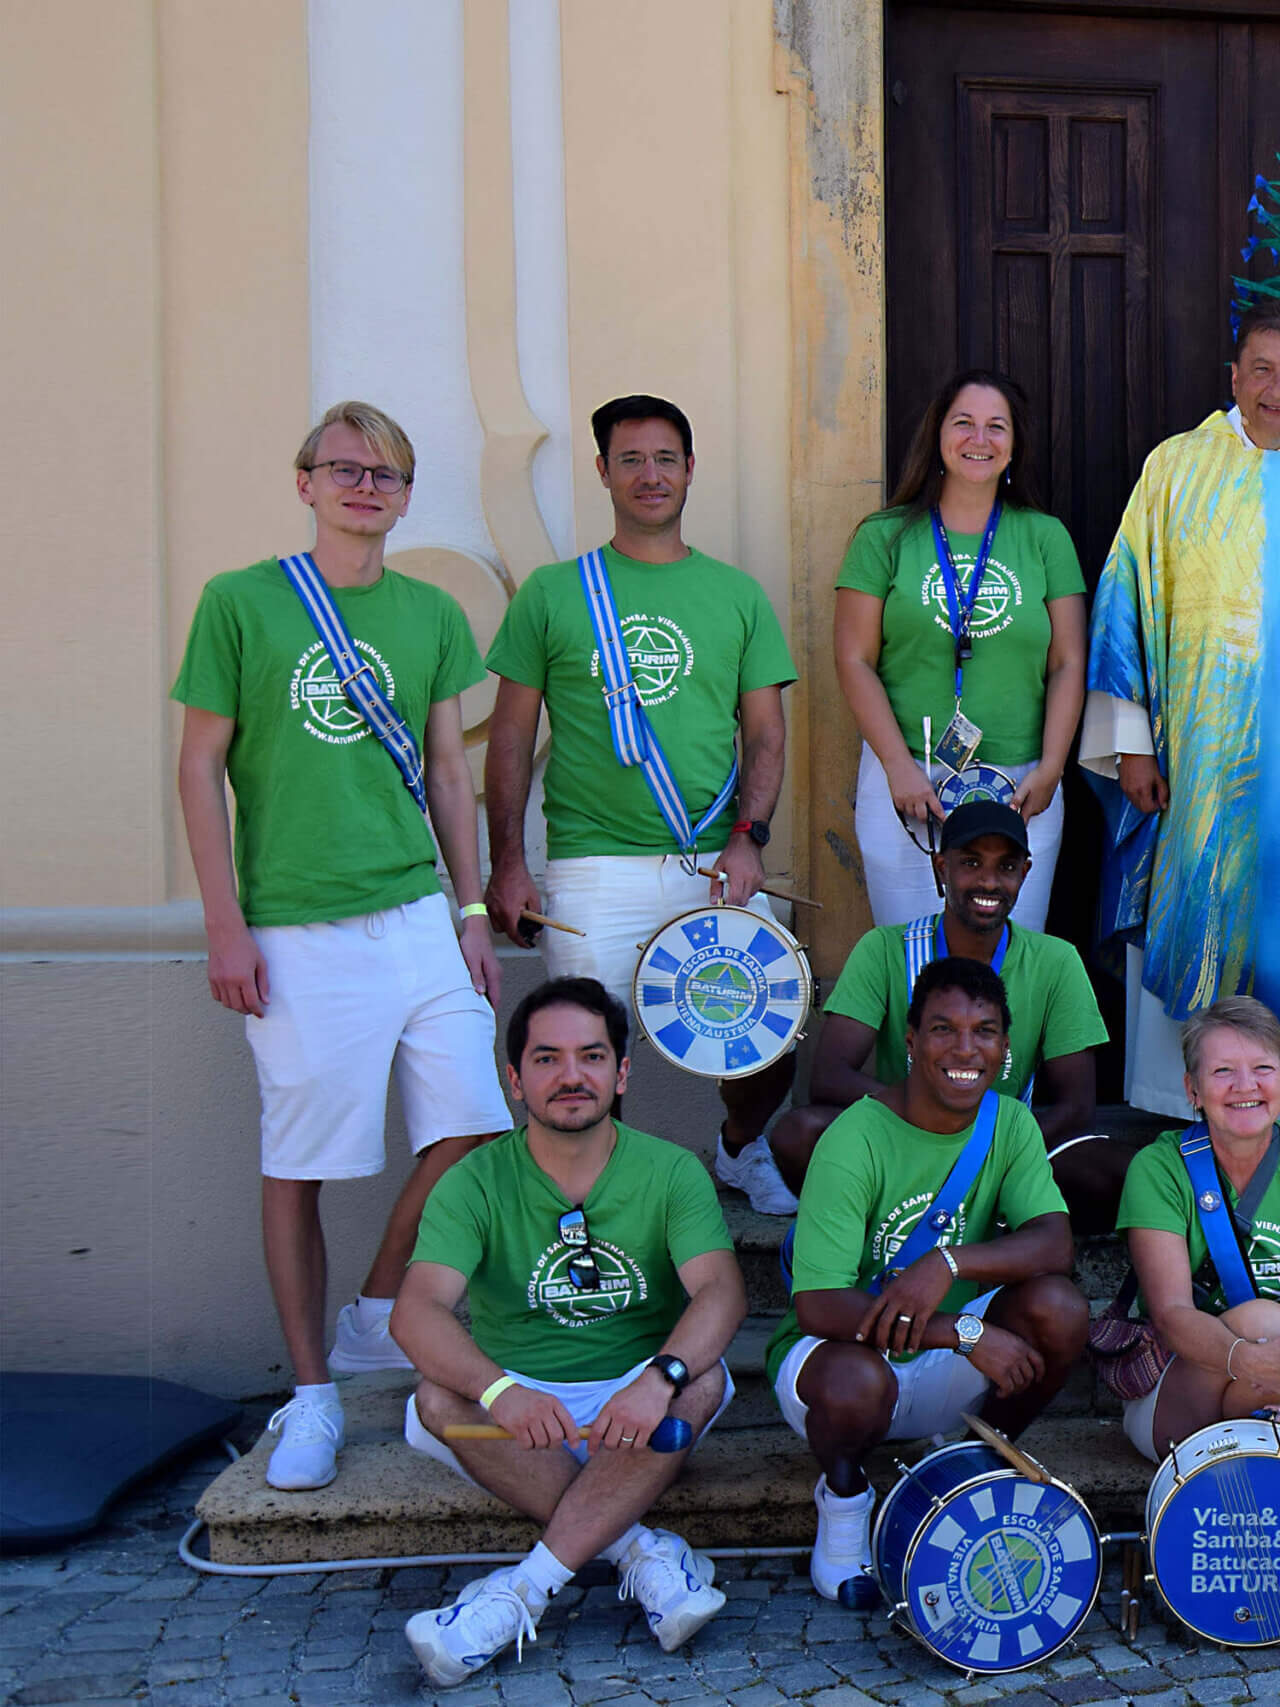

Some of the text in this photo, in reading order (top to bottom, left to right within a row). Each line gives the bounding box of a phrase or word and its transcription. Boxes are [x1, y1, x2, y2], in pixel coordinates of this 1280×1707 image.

[290, 668, 303, 710] ESCOLA
[298, 651, 311, 666] DE
[590, 649, 600, 677] ESCO
[681, 948, 767, 993] ESCOLA DE SAMBA
[690, 980, 753, 1001] BATURIM
[872, 1222, 890, 1260] ESCOLA
[887, 1206, 903, 1222] DE
[527, 1269, 541, 1309] ESCOLA
[536, 1253, 549, 1268] DE
[1193, 1507, 1278, 1526] Viena&
[990, 1536, 1026, 1611] BATURIM
[1002, 1514, 1063, 1616] ESCOLA DE SAMBA
